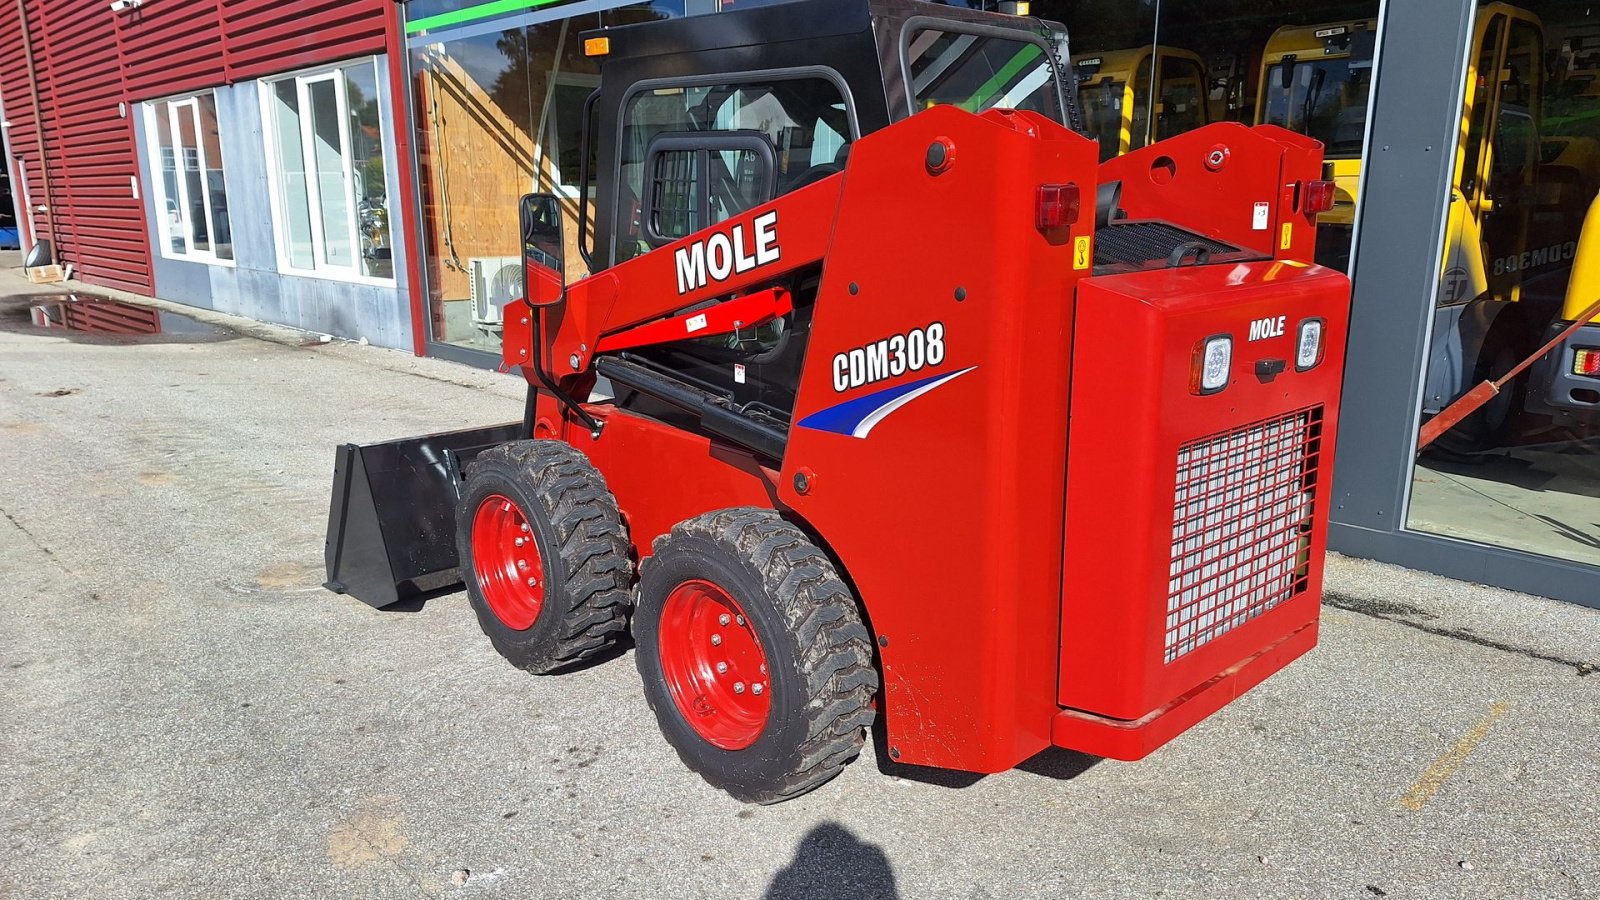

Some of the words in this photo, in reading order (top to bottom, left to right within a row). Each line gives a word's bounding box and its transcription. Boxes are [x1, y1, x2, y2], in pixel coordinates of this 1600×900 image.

[674, 209, 780, 295] MOLE
[832, 321, 945, 393] CDM308
[1248, 314, 1286, 342] MOLE
